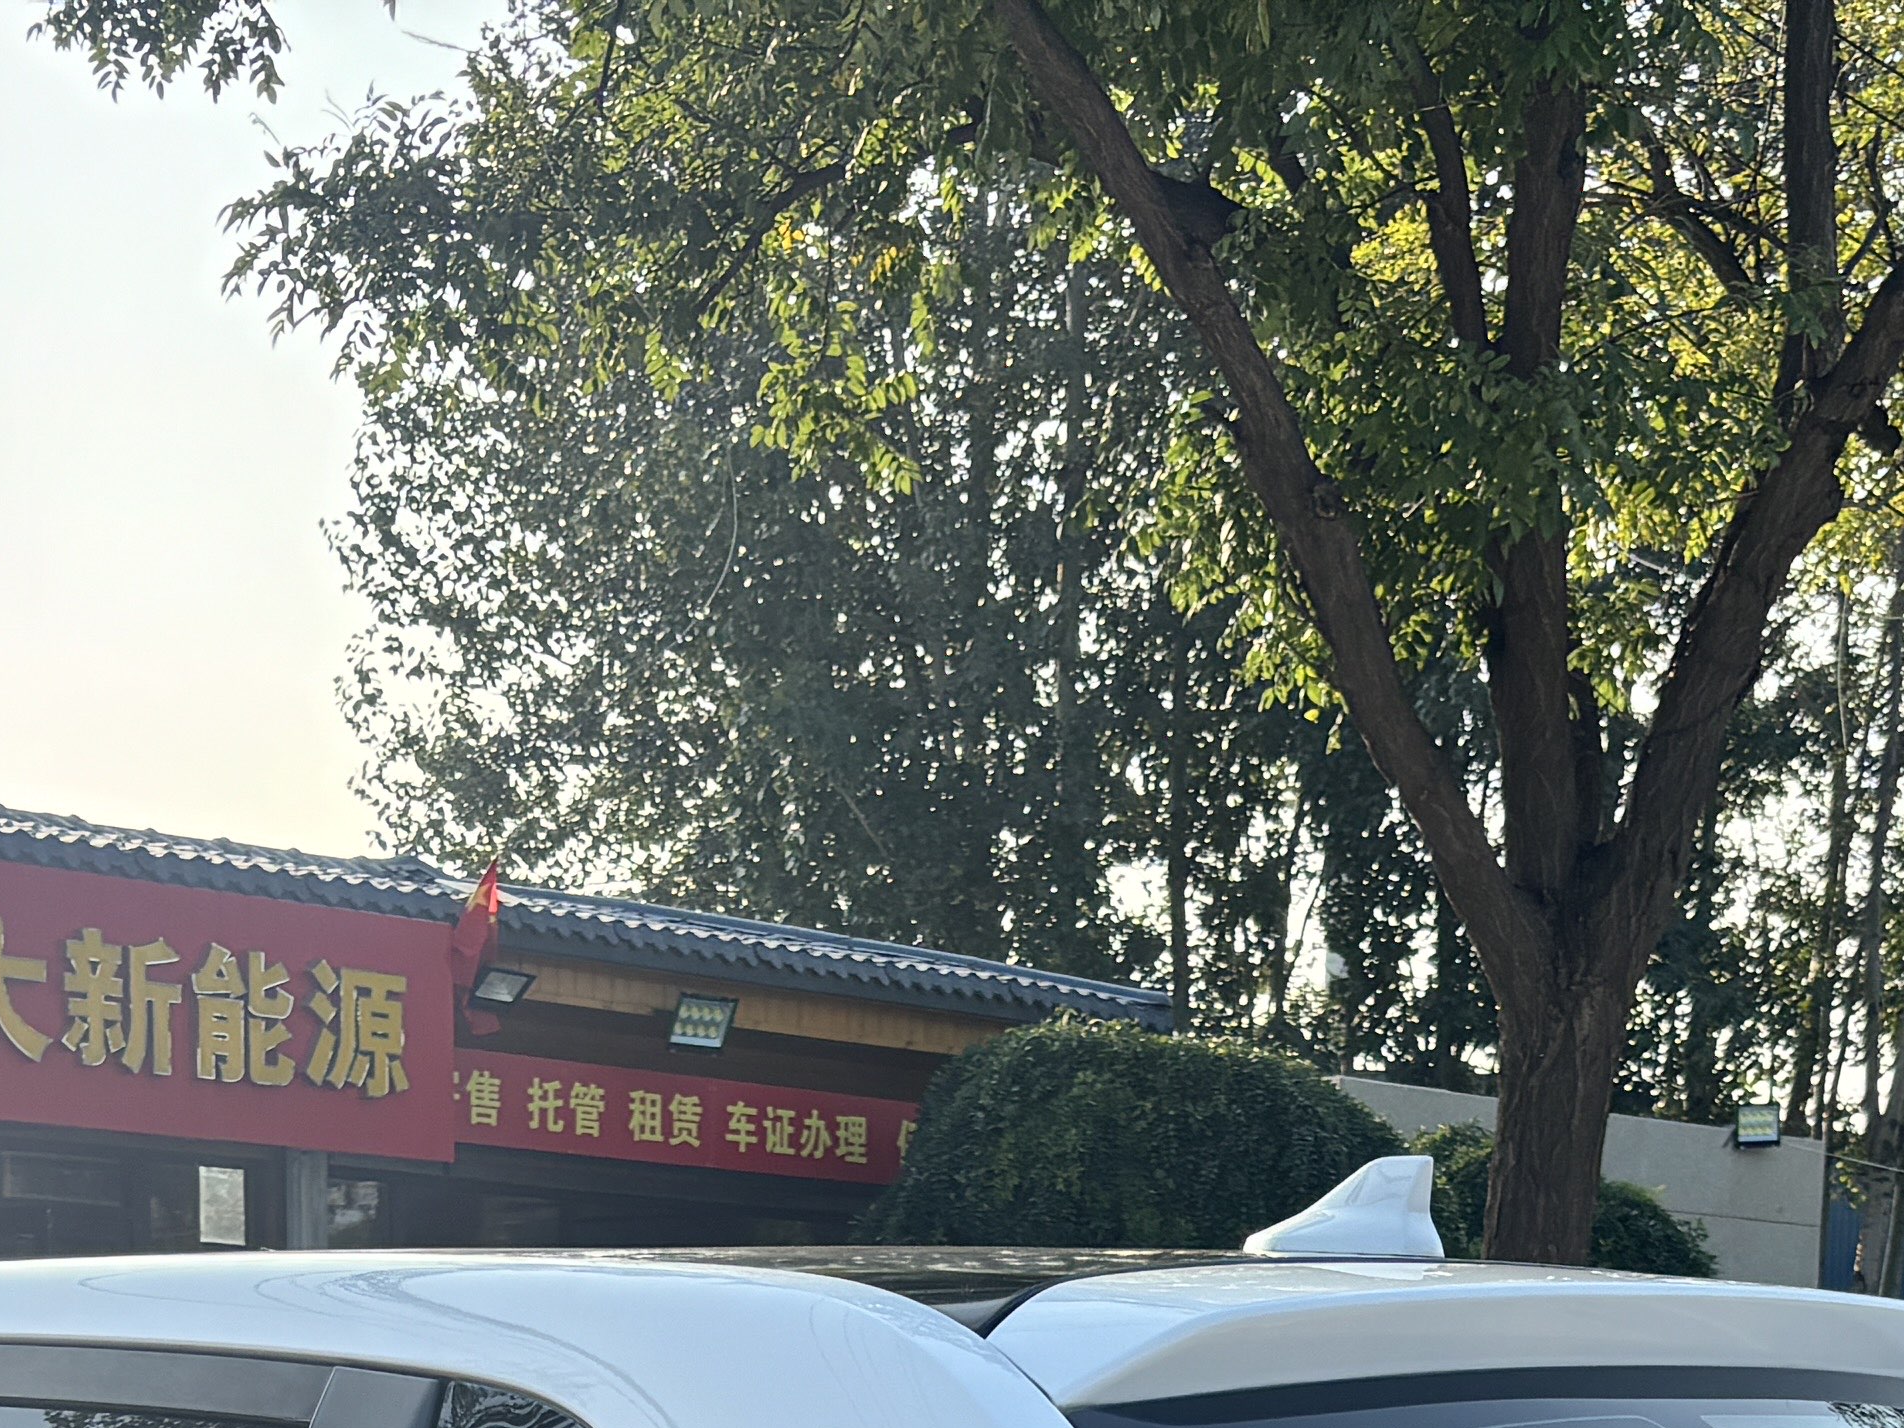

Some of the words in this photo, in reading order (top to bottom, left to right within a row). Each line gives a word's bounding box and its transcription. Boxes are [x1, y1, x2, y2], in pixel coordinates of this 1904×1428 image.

[453, 1070, 501, 1127] 售
[527, 1077, 605, 1138] 托管
[629, 1089, 703, 1148] 租赁
[725, 1101, 868, 1164] 车证办理
